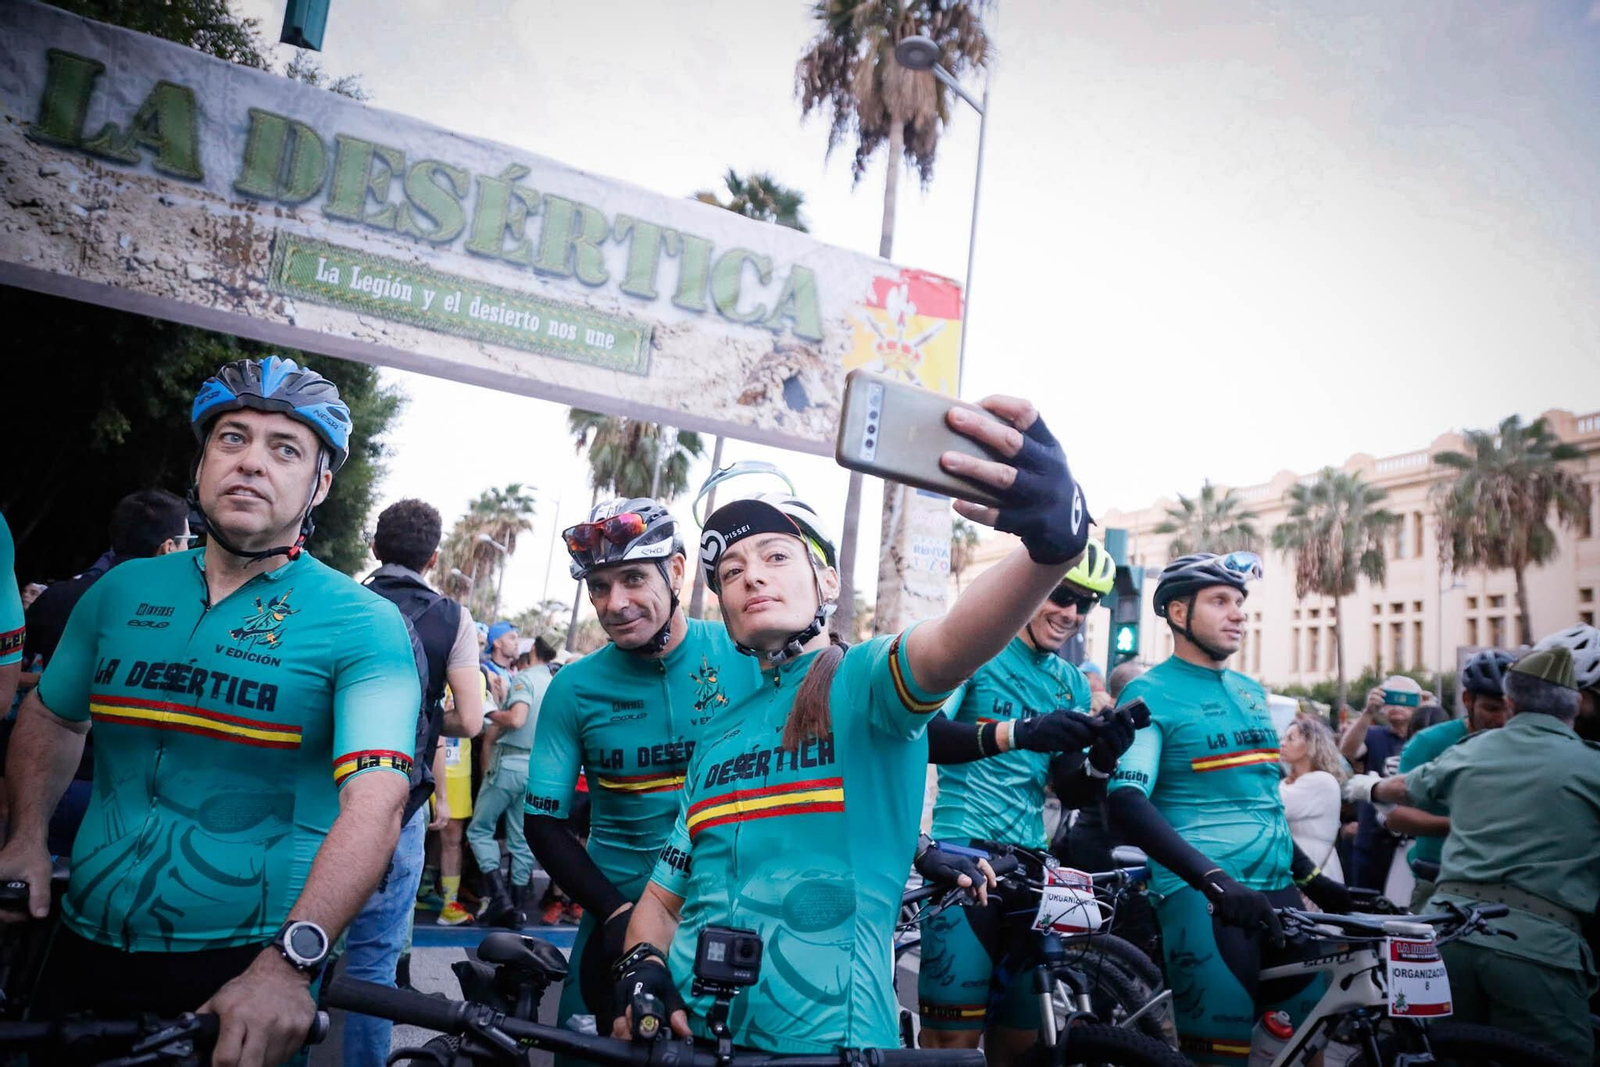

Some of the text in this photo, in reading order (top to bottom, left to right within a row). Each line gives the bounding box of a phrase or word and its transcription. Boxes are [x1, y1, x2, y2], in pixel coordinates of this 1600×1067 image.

[29, 48, 823, 341] LA DESÉRTICA
[316, 257, 615, 350] La Legión y el desierto nos une
[724, 524, 750, 541] PISSEI
[215, 644, 282, 667] V EDICIÓN
[94, 657, 279, 711] LA DESÉRTICA
[993, 698, 1013, 717] LA
[1207, 733, 1228, 750] LA
[600, 749, 624, 769] LA
